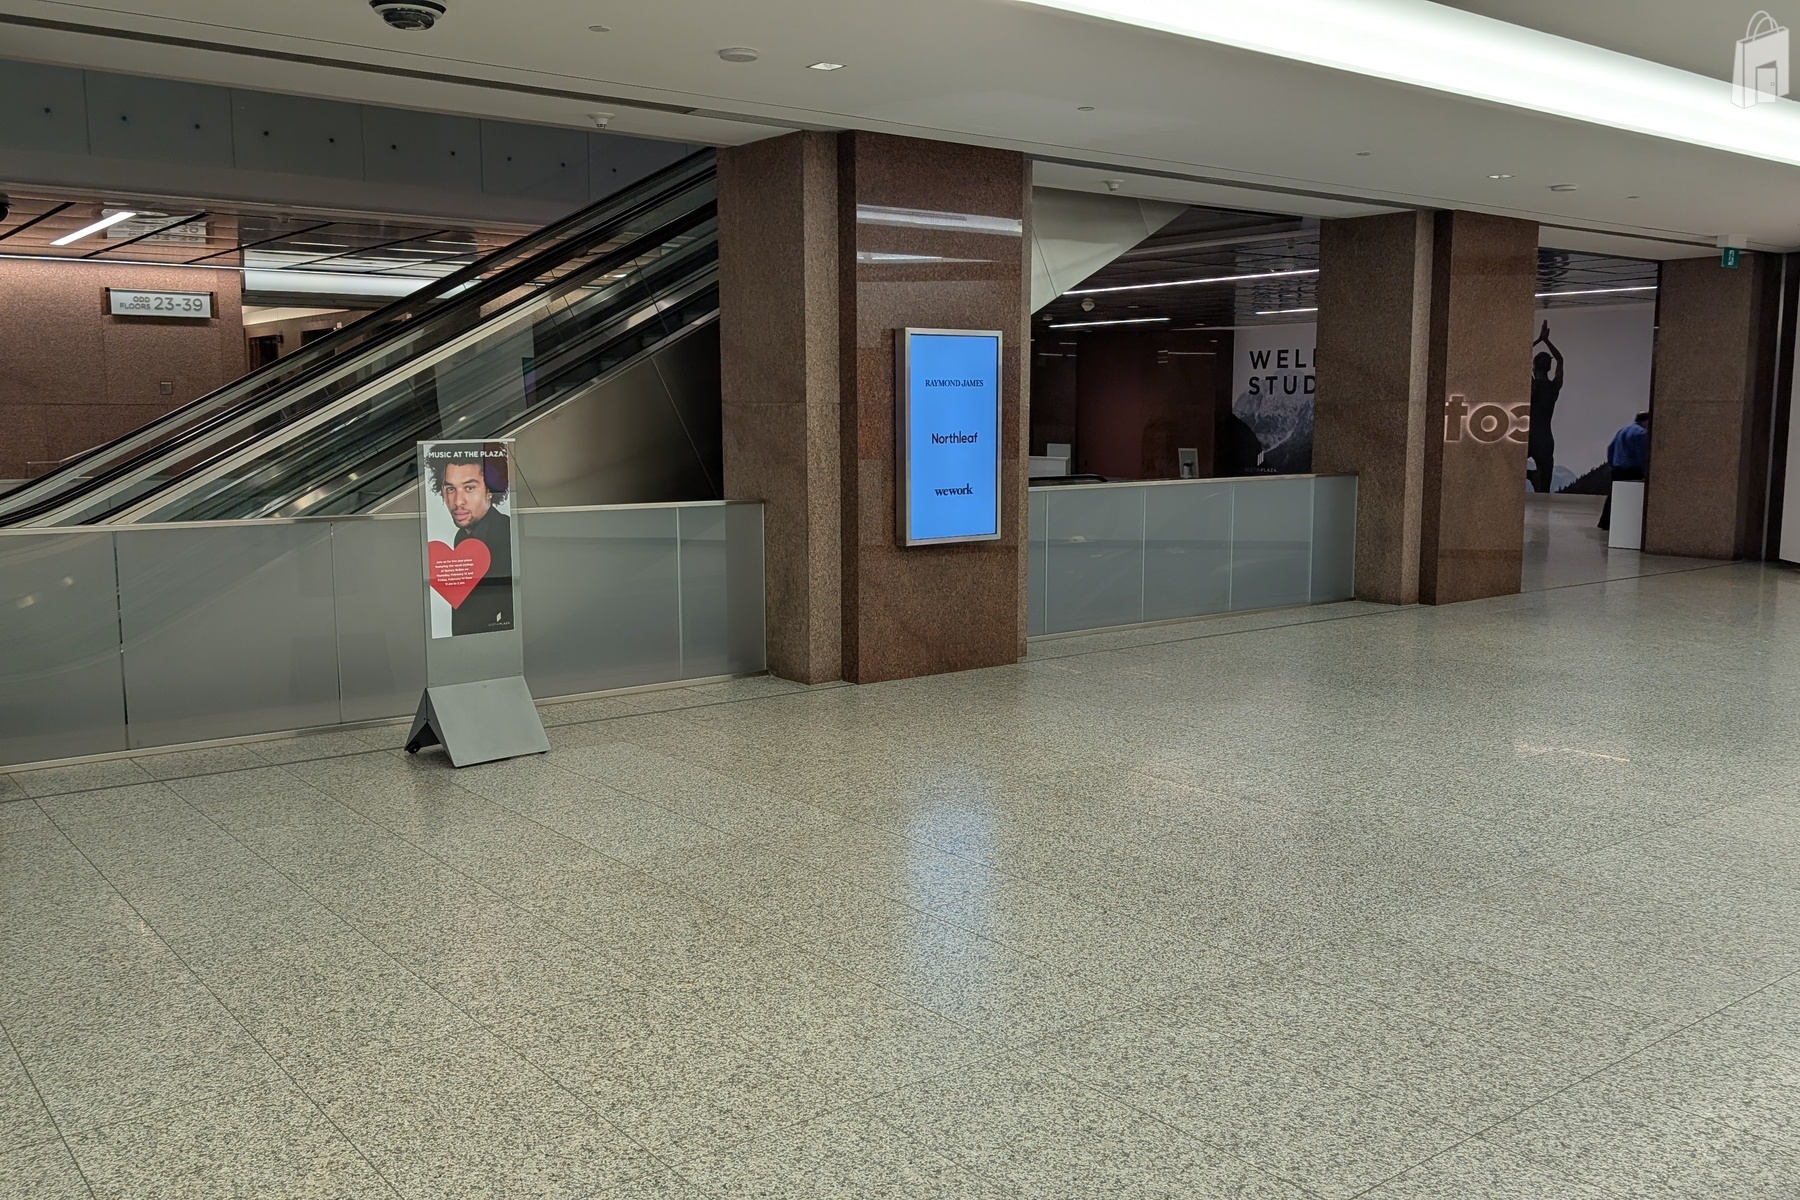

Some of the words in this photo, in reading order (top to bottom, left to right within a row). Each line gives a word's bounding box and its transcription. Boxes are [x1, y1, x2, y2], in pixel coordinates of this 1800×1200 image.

[132, 295, 151, 303] ODD
[153, 296, 203, 312] 23-39
[1249, 348, 1316, 370] WEL
[925, 379, 961, 387] RAYMOND
[961, 379, 984, 388] JAMES
[931, 430, 979, 445] Northleaf
[428, 451, 452, 459] MUSIC
[480, 450, 504, 458] PLAZA
[934, 483, 974, 496] wework
